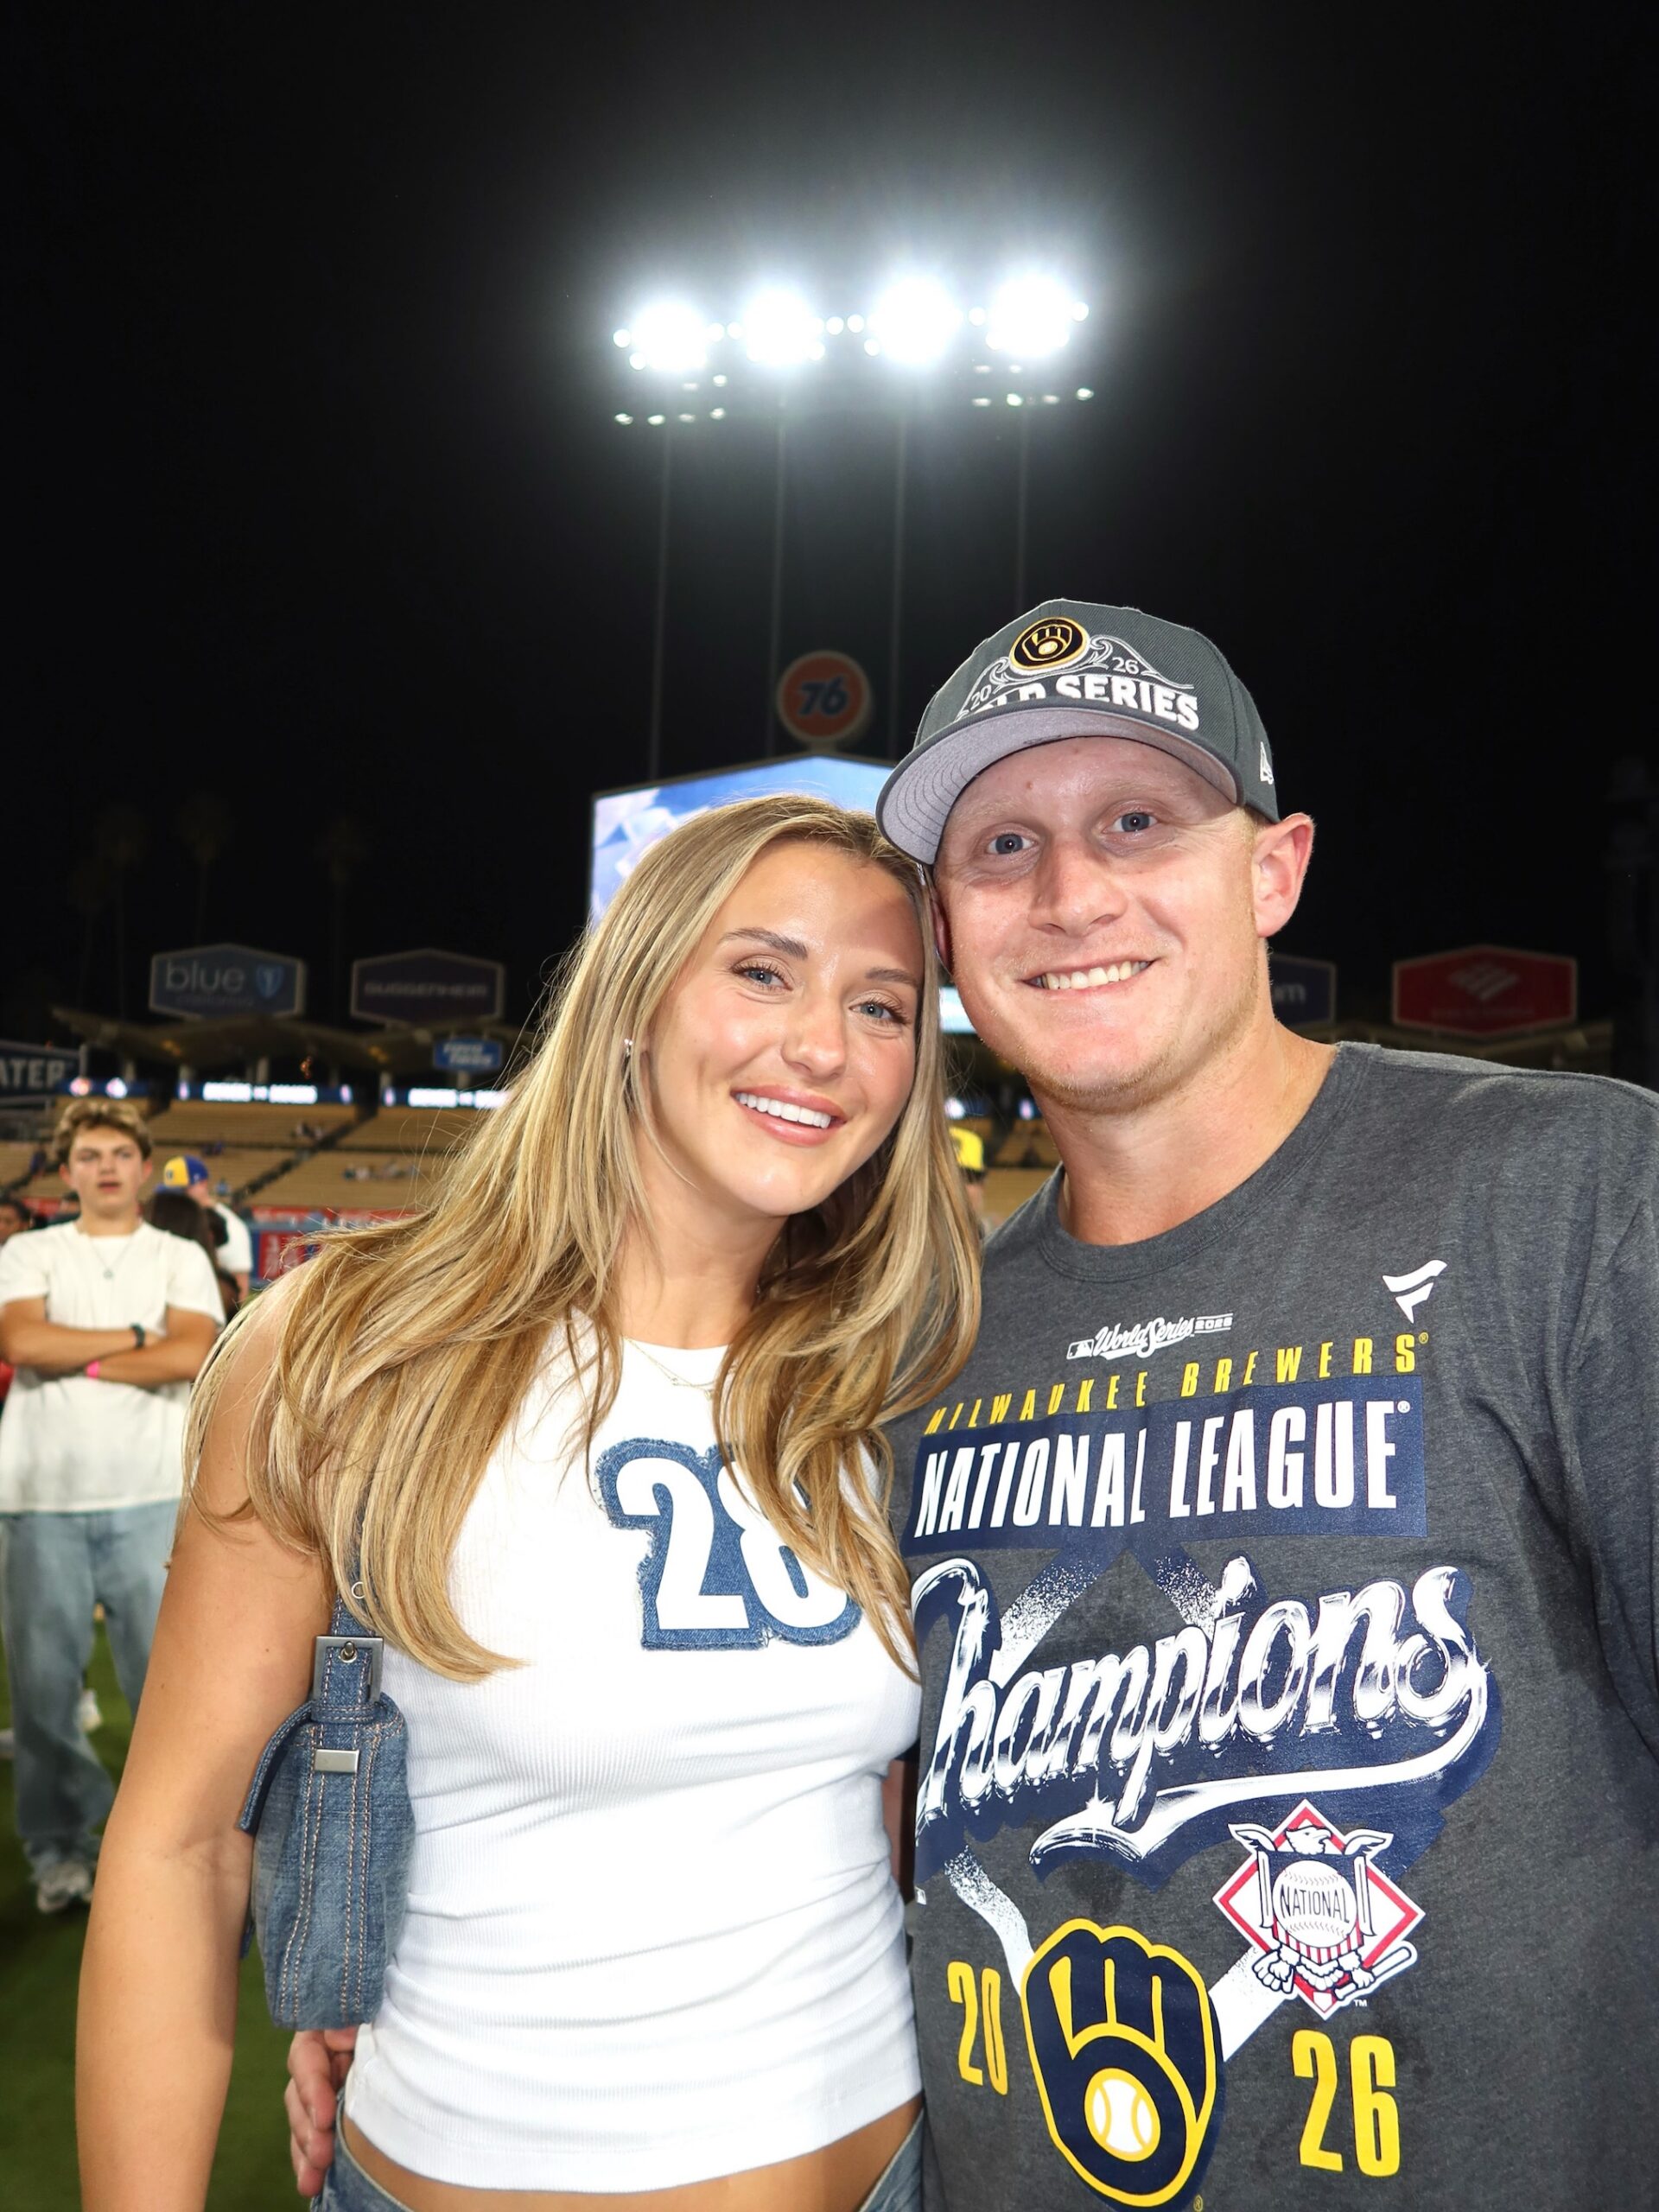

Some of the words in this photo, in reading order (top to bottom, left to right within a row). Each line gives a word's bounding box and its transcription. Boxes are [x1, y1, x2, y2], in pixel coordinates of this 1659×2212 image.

[798, 674, 849, 715] 76
[971, 684, 990, 709] 20
[1112, 657, 1140, 675] 26
[1055, 674, 1200, 731] SERIES
[165, 959, 245, 995] blue
[1093, 1321, 1150, 1358] World
[1137, 1317, 1196, 1358] Series
[924, 1370, 1148, 1436] MILWAUKEE
[1180, 1333, 1416, 1397] BREWERS
[914, 1427, 1147, 1538] NATIONAL
[1169, 1401, 1397, 1519] LEAGUE
[1280, 1883, 1350, 1923] NATIONAL
[947, 1961, 1008, 2095] 20
[1292, 2029, 1402, 2178] 26
